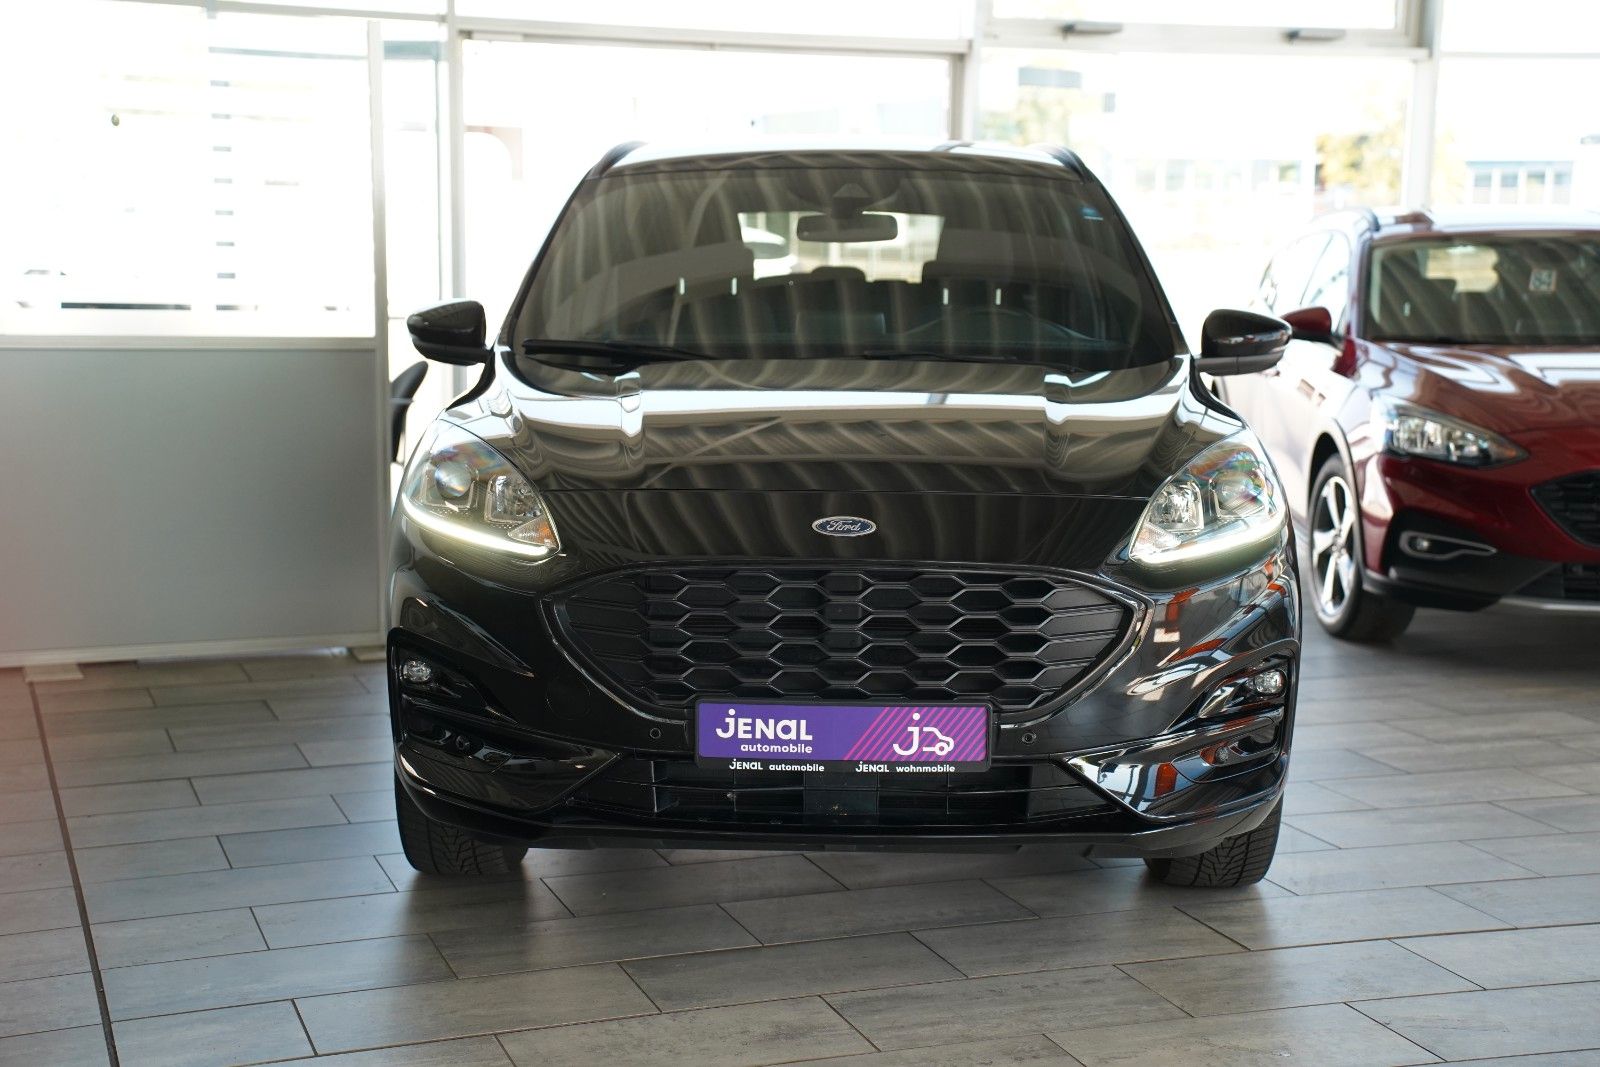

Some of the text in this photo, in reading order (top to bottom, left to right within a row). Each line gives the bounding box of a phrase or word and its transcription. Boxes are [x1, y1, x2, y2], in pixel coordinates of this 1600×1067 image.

[826, 520, 861, 531] Ford
[740, 743, 813, 754] automobile
[768, 763, 825, 772] automobile
[895, 764, 956, 773] wohnmobile
